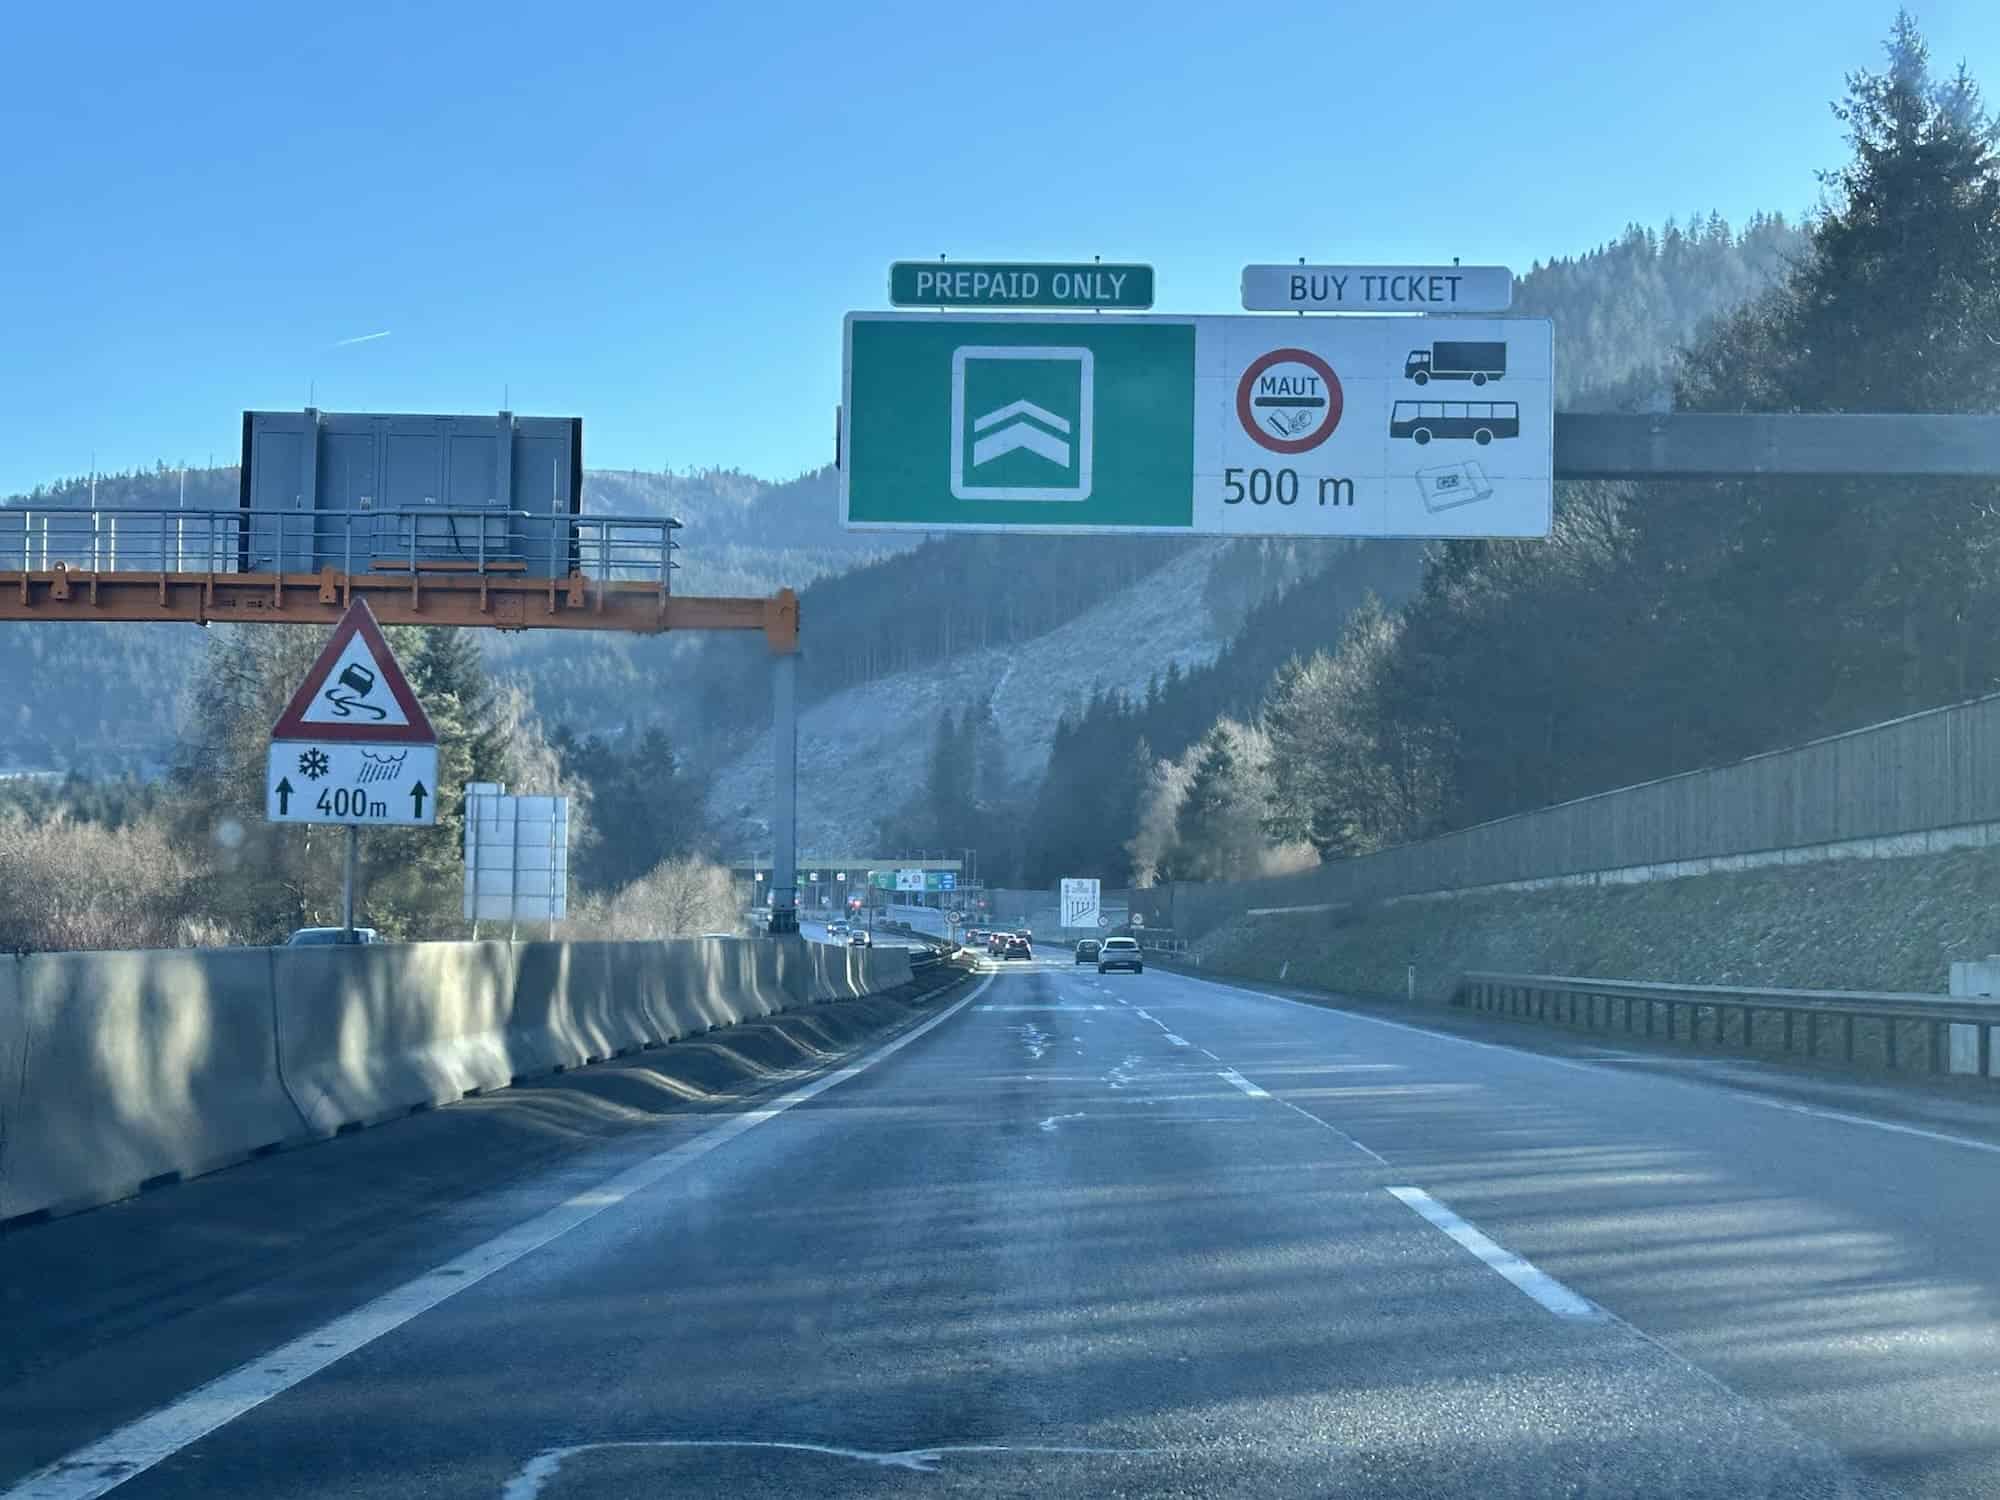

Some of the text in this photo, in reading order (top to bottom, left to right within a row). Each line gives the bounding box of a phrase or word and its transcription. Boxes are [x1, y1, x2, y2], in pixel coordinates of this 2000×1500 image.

[916, 270, 1128, 301] PREPAID ONLY
[1290, 274, 1464, 303] BUY TICKET
[1260, 375, 1321, 396] MAUT
[1223, 467, 1355, 507] 500 m
